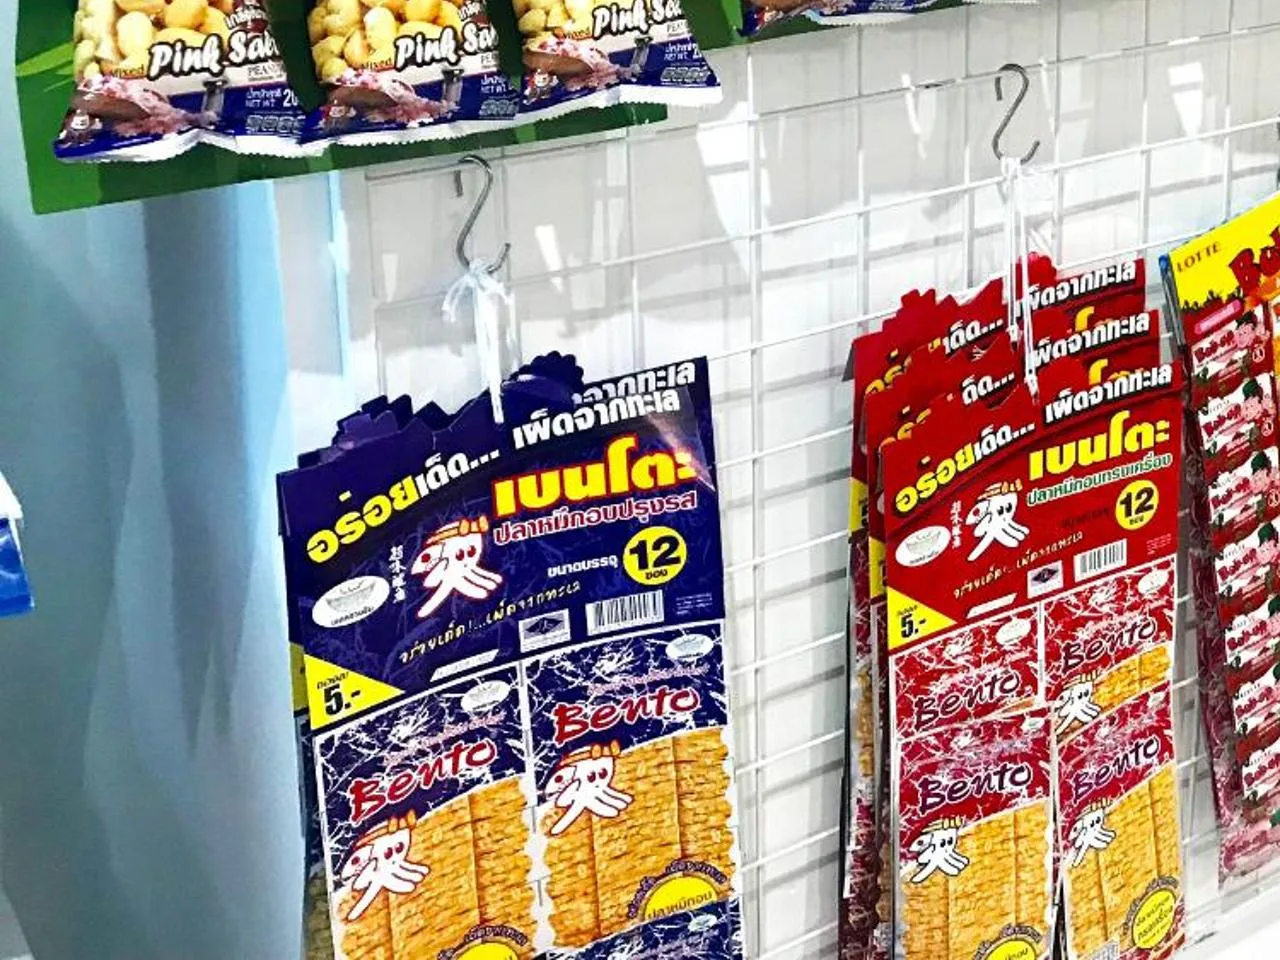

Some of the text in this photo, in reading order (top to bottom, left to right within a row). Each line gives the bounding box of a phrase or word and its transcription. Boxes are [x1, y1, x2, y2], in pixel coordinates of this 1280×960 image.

[1177, 240, 1222, 274] LOTTE
[512, 391, 681, 450] เผ็ดจากทะเล
[1044, 363, 1174, 424] เผ็ดจากทะเล
[491, 431, 699, 519] เบนโตะ
[1028, 409, 1171, 481] เบนโตะ
[1119, 485, 1156, 519] 12
[628, 538, 682, 572] 12
[1061, 619, 1157, 672] Bento
[552, 685, 702, 746] Bento
[914, 670, 1021, 732] Bento
[349, 738, 500, 825] Bento
[918, 759, 1033, 817] Bento
[1070, 734, 1163, 805] Bento
